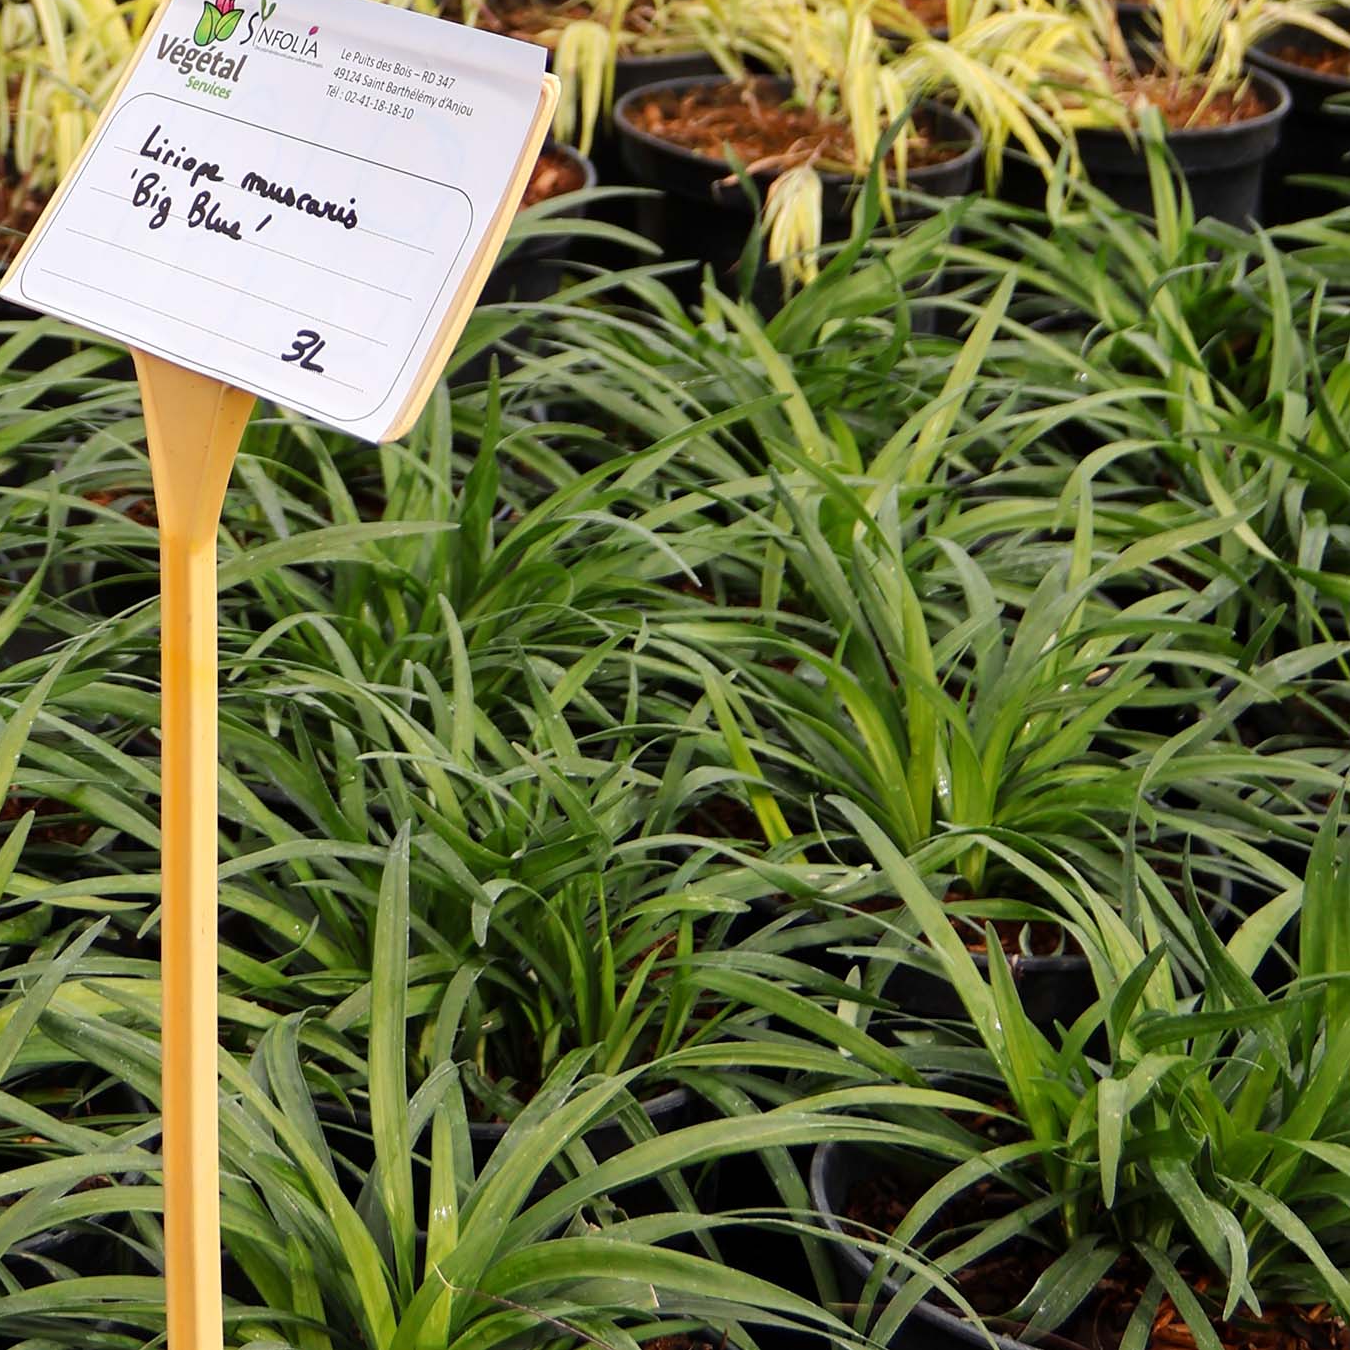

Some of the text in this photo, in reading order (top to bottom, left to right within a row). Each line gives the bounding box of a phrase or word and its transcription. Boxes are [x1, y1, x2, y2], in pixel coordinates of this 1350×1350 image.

[156, 33, 248, 82] Végétal
[340, 48, 351, 60] Le
[352, 51, 375, 68] Puits
[376, 58, 391, 72] des
[393, 62, 413, 78] Bois
[421, 70, 435, 84] RD
[436, 75, 456, 89] 347
[185, 75, 232, 100] Services
[326, 84, 341, 98] Tél
[344, 90, 414, 120] 02-41-18-18-10
[333, 67, 473, 116] 49124 Saint Barthélémy d'Anjou
[140, 125, 224, 187] Liriope
[281, 329, 324, 373] 3L
